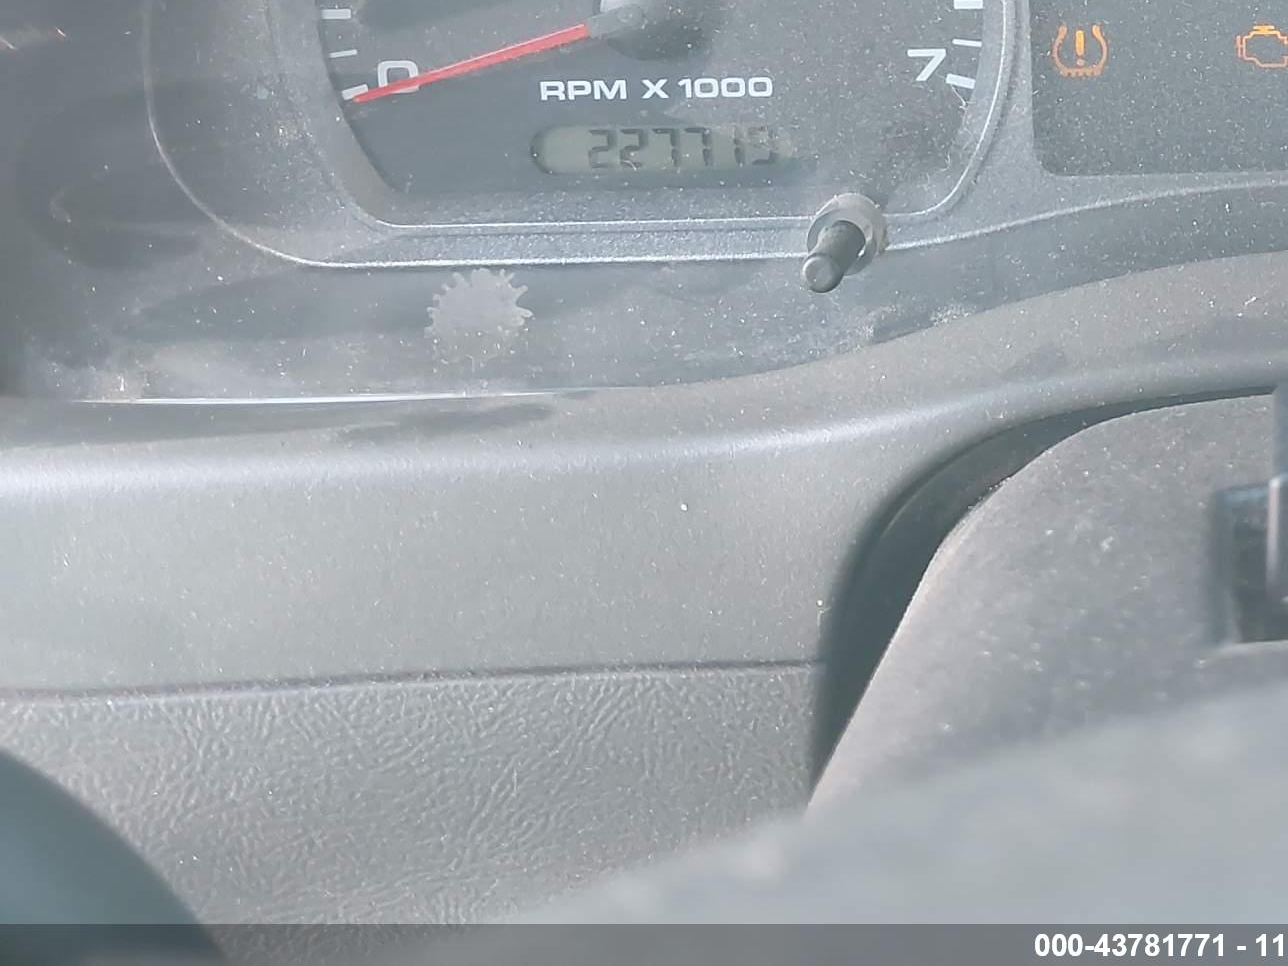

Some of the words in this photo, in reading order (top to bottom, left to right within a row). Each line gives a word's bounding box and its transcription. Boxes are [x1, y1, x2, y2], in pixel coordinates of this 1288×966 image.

[377, 60, 419, 94] 0
[907, 48, 946, 81] 7
[540, 79, 627, 101] RPM
[642, 78, 669, 99] X
[678, 76, 773, 99] 1000
